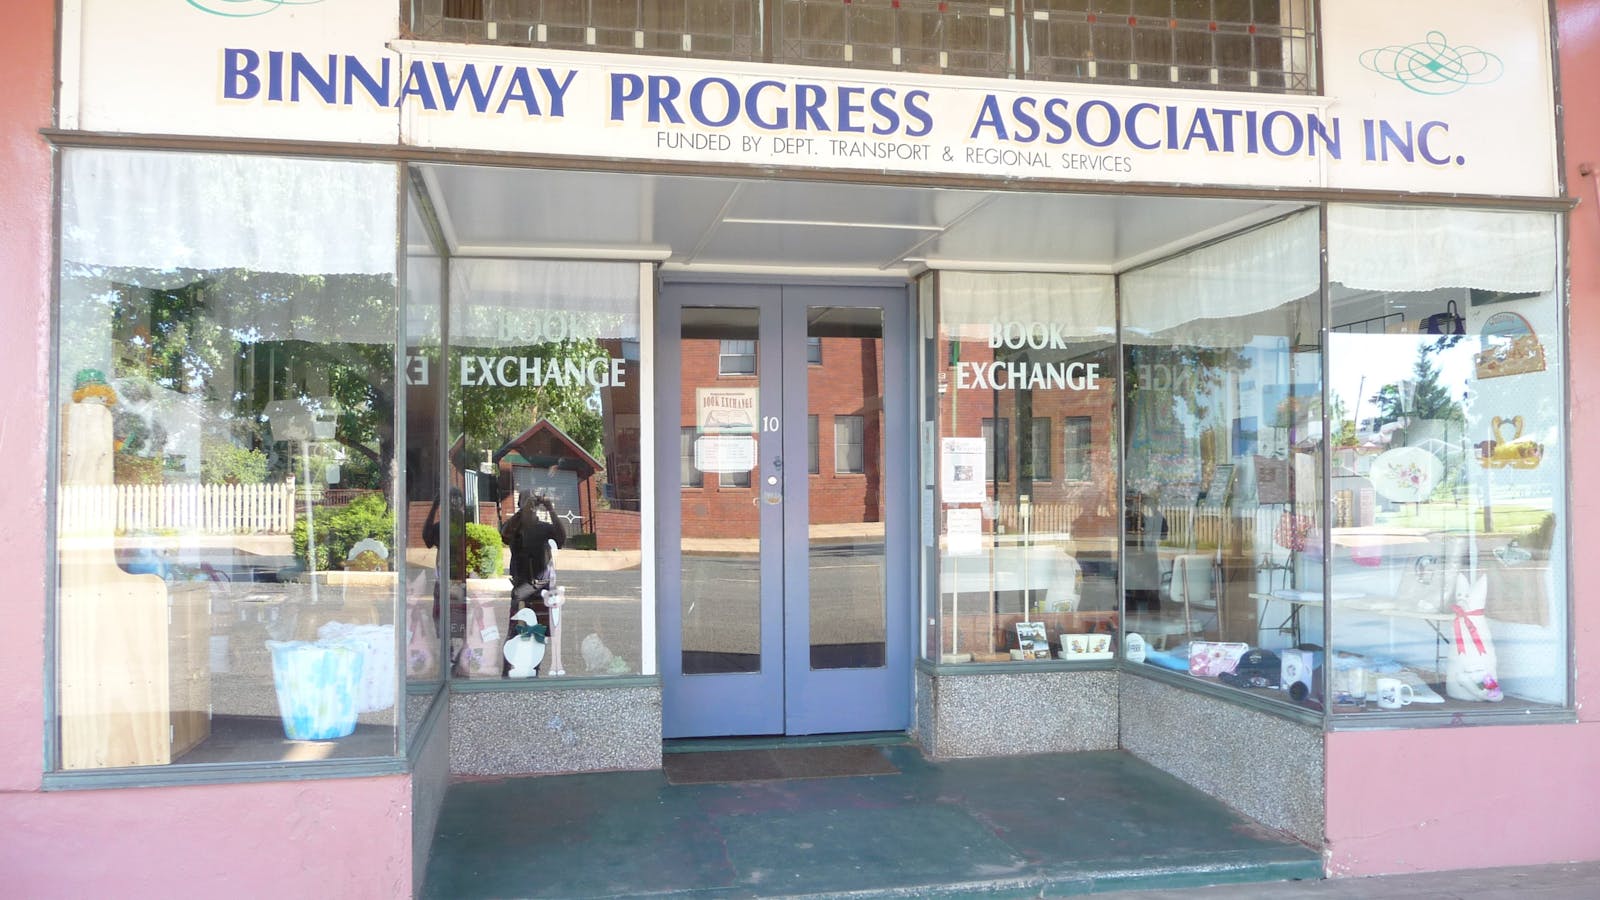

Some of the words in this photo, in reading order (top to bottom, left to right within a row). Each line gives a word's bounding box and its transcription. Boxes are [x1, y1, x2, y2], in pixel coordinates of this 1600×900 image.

[223, 48, 578, 117] BINNAWAY
[609, 72, 933, 137] PROGRESS
[971, 94, 1341, 159] ASSOCIATION
[1363, 119, 1465, 165] INC.
[657, 132, 731, 151] FUNDED
[742, 136, 762, 152] BY
[773, 137, 818, 155] DEPT.
[829, 140, 931, 160] TRANSPORT
[942, 146, 954, 162] &
[966, 147, 1051, 168] REGIONAL
[1062, 153, 1132, 172] SERVICES
[498, 312, 595, 343] BOOK
[988, 321, 1067, 350] BOOK
[460, 356, 626, 388] EXCHANGE
[957, 361, 1100, 391] EXCHANGE
[763, 416, 779, 432] 10
